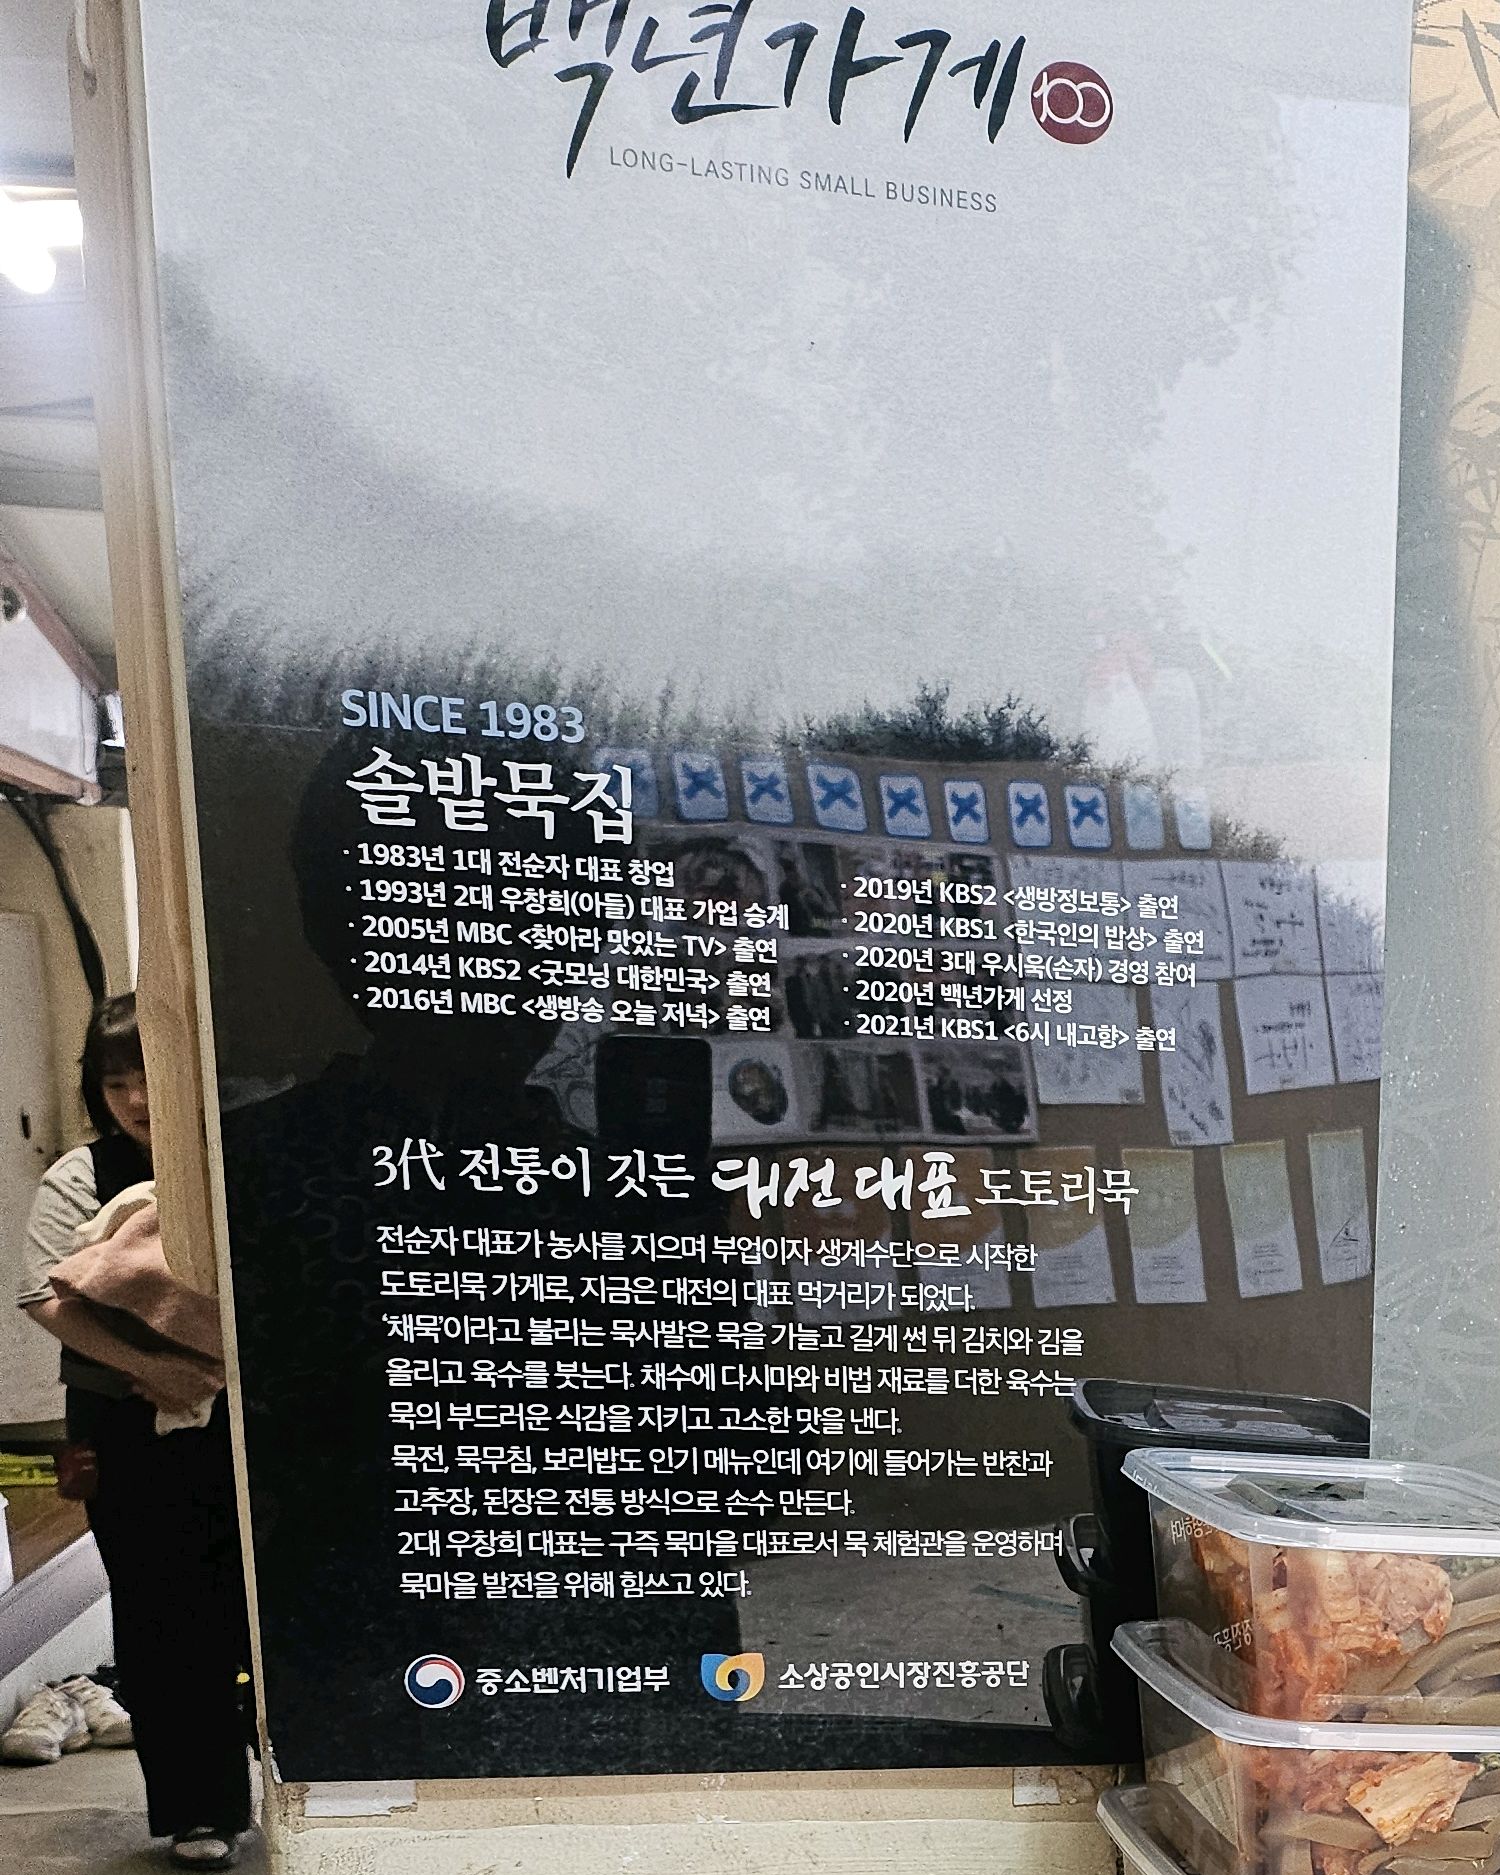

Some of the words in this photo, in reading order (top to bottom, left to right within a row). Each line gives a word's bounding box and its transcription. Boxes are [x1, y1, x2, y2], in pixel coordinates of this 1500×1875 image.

[610, 147, 790, 189] LONG-LASTING
[800, 171, 875, 200] SMALL
[885, 180, 997, 214] BUSINESS
[341, 689, 466, 735] SINCE
[480, 700, 585, 743] 1983
[345, 746, 634, 844] 솔밭묵집
[357, 843, 445, 873] 1983년
[453, 849, 492, 875] 1대
[498, 852, 570, 881] 전순자
[576, 857, 623, 884] 대표
[628, 860, 675, 887] 창업
[360, 880, 447, 909] 1993년
[454, 885, 493, 913] 2대
[499, 888, 635, 919] 우창희(아들)
[641, 897, 687, 923] 대표
[692, 900, 739, 928] 가업
[743, 903, 789, 931] 승계
[853, 877, 933, 905] 2019년
[940, 882, 997, 906] KBS2
[1003, 885, 1130, 916] <생방정보통>
[1137, 893, 1179, 920] 출연
[362, 916, 449, 945] 2005년
[457, 922, 511, 946] MBC
[518, 924, 601, 955] <찾아라
[607, 930, 677, 958] 맛있는
[684, 935, 726, 960] TV>
[732, 937, 778, 965] 출연
[854, 911, 933, 939] 2020년
[940, 917, 998, 940] KBS1
[1003, 919, 1099, 950] <한국인의
[1105, 925, 1157, 952] 밥상>
[1163, 929, 1204, 955] 출연
[364, 952, 452, 980] 2014년
[458, 958, 521, 980] KBS2
[527, 960, 610, 990] <굿모닝
[616, 966, 719, 995] 대한민국>
[727, 971, 772, 998] 출연
[855, 946, 933, 973] 2020년
[941, 949, 975, 974] 3대
[981, 951, 1102, 983] 우시욱(손자)
[1107, 959, 1149, 985] 경영
[1155, 962, 1196, 987] 참여
[856, 980, 934, 1007] 2020년
[941, 984, 1025, 1012] 백년가게
[1031, 987, 1073, 1014] 선정
[856, 1013, 935, 1041] 2021년
[942, 1017, 998, 1041] KBS1
[1004, 1021, 1050, 1048] <6시
[1056, 1023, 1129, 1051] 내고향>
[1135, 1026, 1177, 1052] 출연
[372, 1138, 445, 1191] 3代
[459, 1142, 591, 1198] 전통이
[607, 1149, 695, 1198] 깃든
[712, 1155, 843, 1219] 대전
[855, 1151, 972, 1220] 대표
[975, 1166, 1140, 1215] 도토리묵
[376, 1225, 459, 1257] 전순자
[463, 1228, 543, 1258] 대표가
[548, 1229, 627, 1261] 농사를
[631, 1232, 706, 1263] 지으며
[713, 1236, 812, 1267] 부업이자
[816, 1239, 962, 1269] 생계수단으로
[966, 1242, 1038, 1272] 시작한
[400, 1571, 479, 1599] 묵마을
[482, 1571, 560, 1599] 발전을
[564, 1571, 614, 1599] 위해
[619, 1571, 694, 1598] 힘쓰고
[699, 1571, 752, 1598] 있다.
[476, 1666, 671, 1696] 중소벤처기업부
[778, 1660, 1030, 1690] 소상공인시장진흥공단
